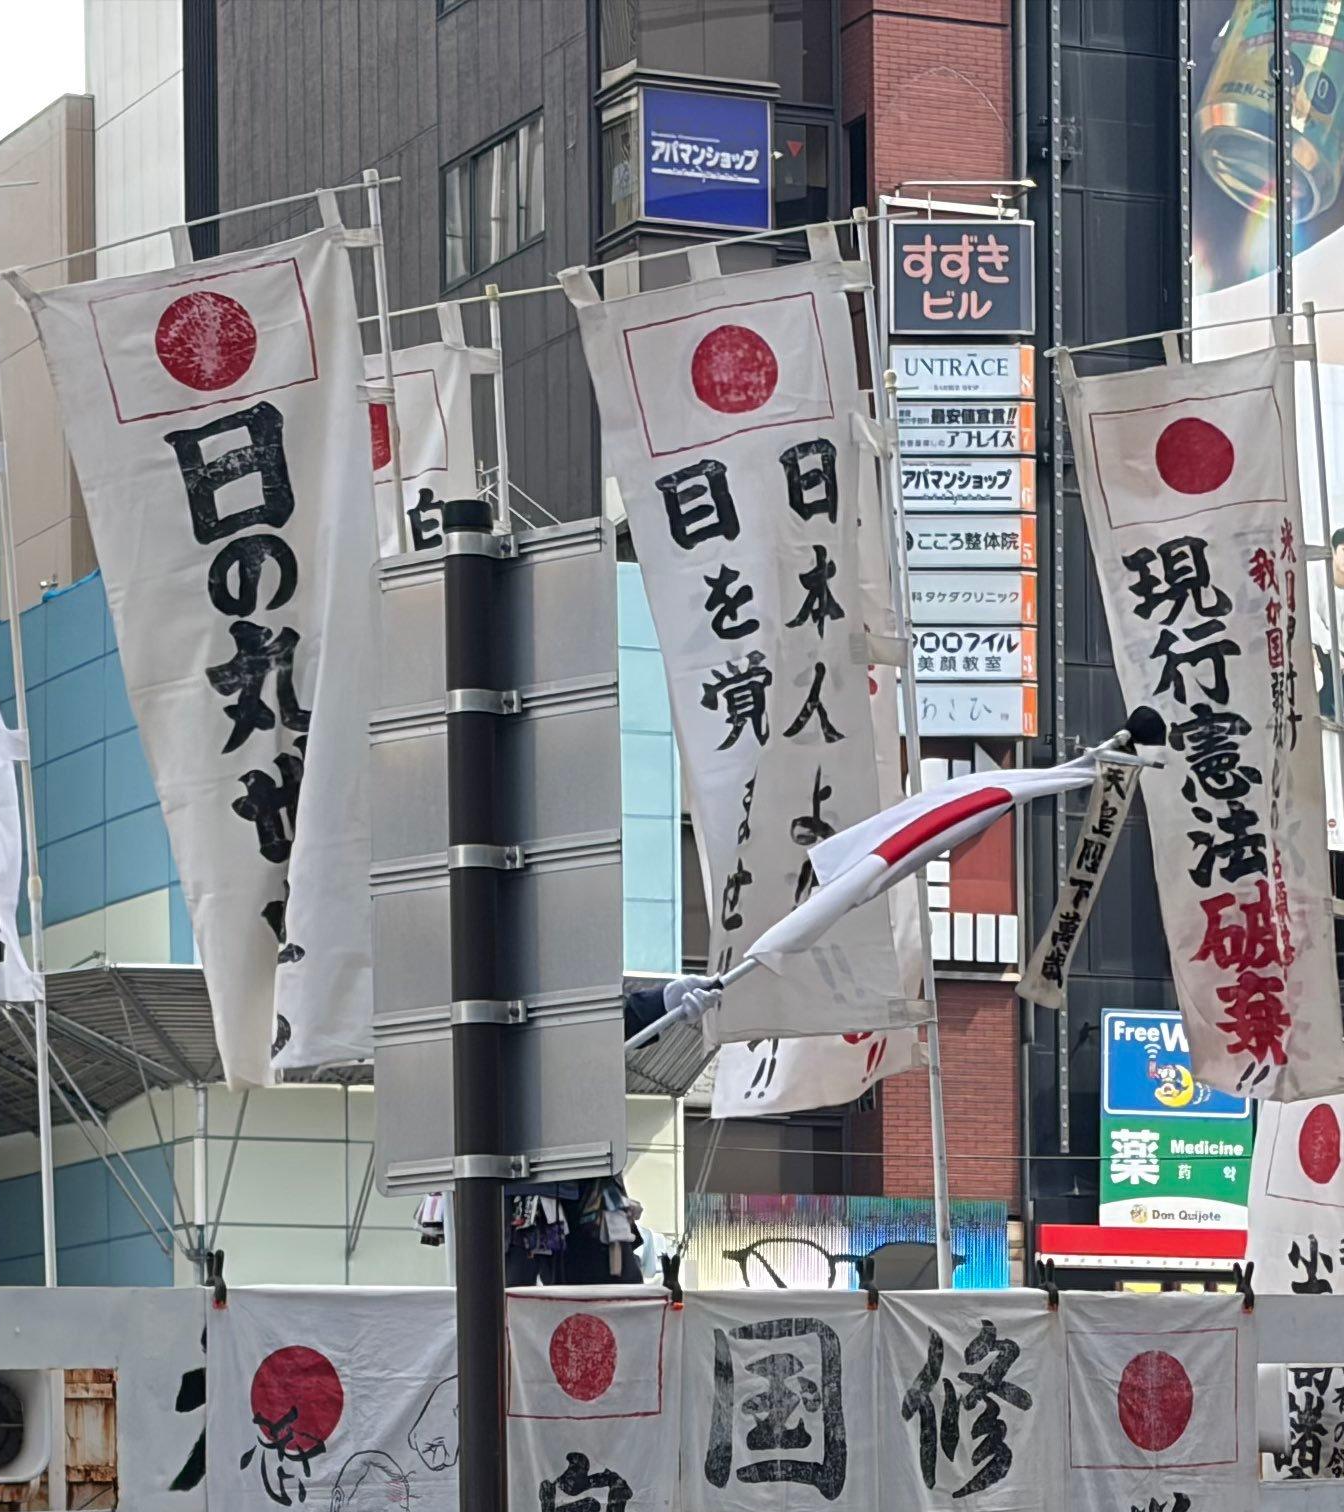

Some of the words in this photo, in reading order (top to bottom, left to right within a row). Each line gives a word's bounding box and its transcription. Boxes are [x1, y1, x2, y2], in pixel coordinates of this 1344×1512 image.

[651, 140, 759, 171] アパマンショップ
[902, 233, 1010, 285] すずき
[923, 290, 993, 320] ビル
[901, 468, 1013, 490] アパマンショップ
[917, 532, 1019, 551] こころ整体院
[917, 655, 1002, 672] 美顔教室
[1109, 1128, 1160, 1186] 薬
[1170, 1139, 1244, 1156] Medicine
